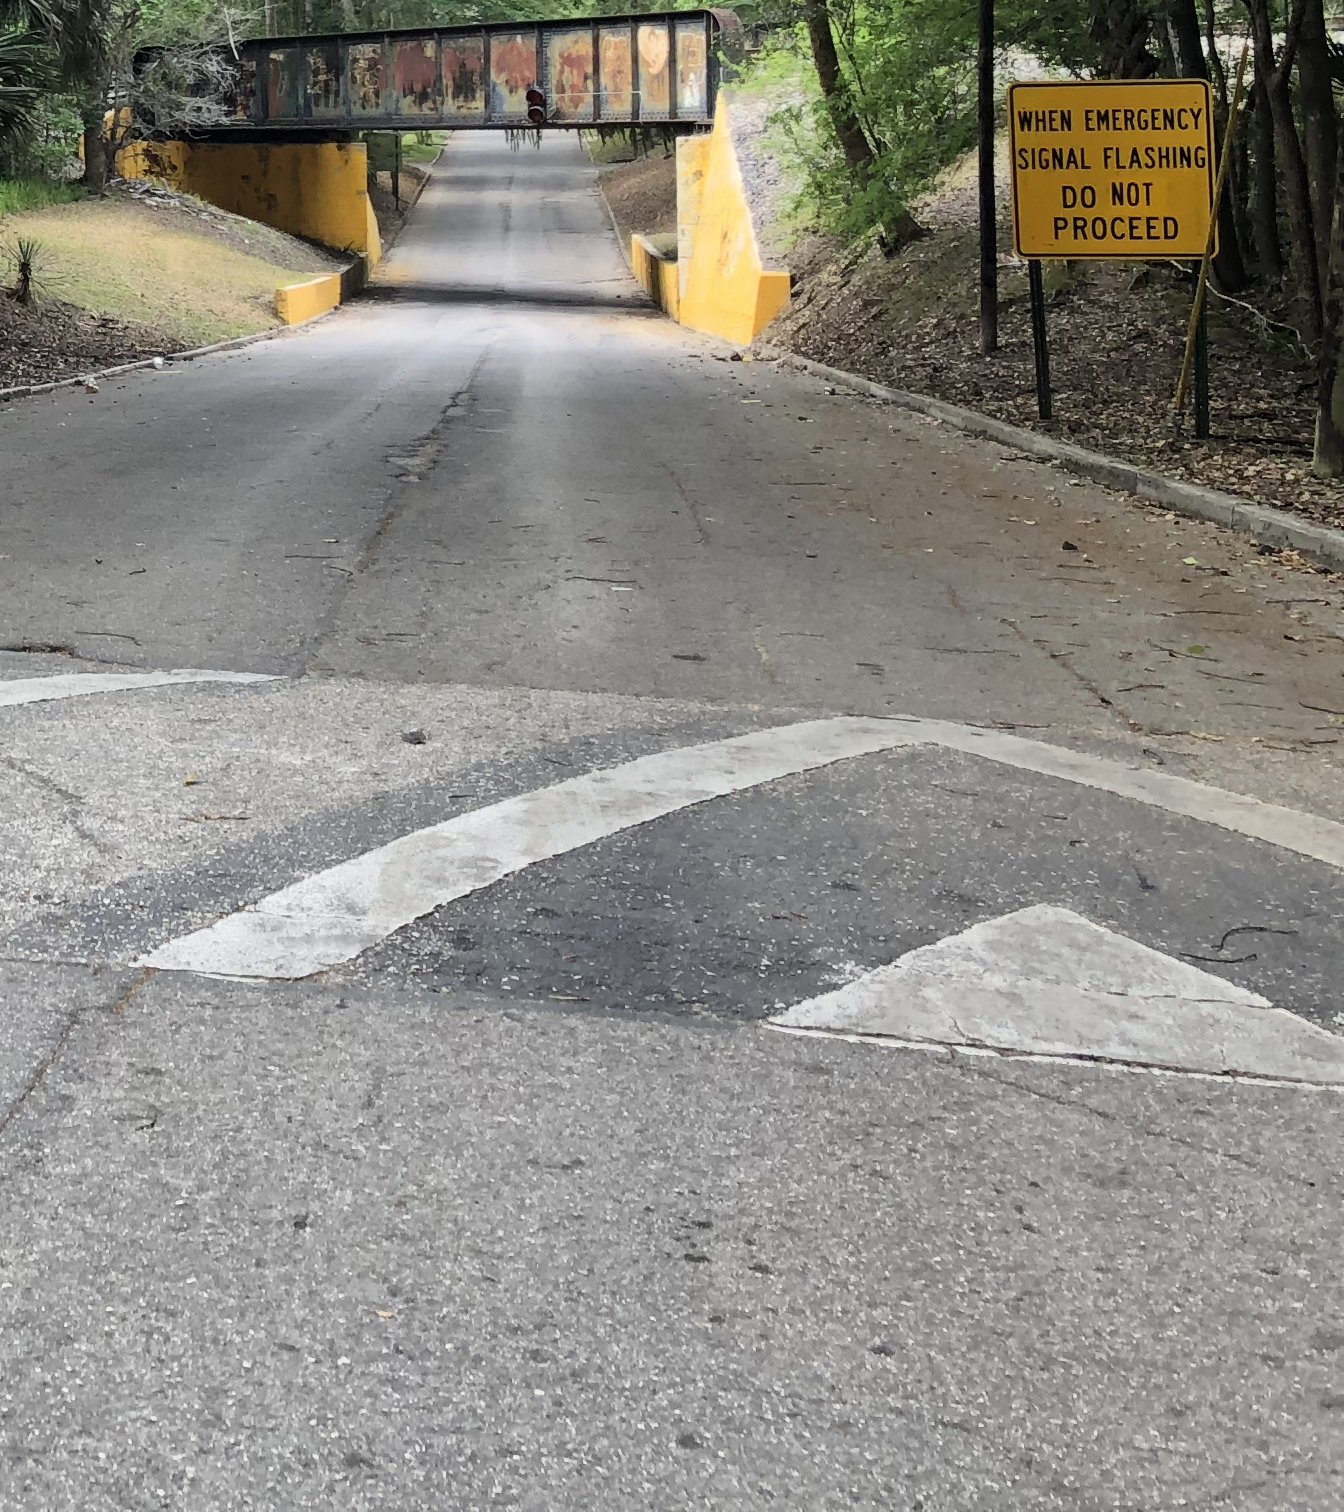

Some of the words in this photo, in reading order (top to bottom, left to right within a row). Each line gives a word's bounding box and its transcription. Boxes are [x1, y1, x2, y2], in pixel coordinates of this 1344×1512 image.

[1018, 109, 1072, 132] WHEN
[1084, 108, 1202, 131] EMERGENCY
[1018, 147, 1091, 169] SIGNAL
[1103, 146, 1206, 169] FLASHING
[1062, 185, 1096, 208] DO
[1111, 182, 1153, 206] NOT
[1053, 216, 1179, 240] PROCEED
